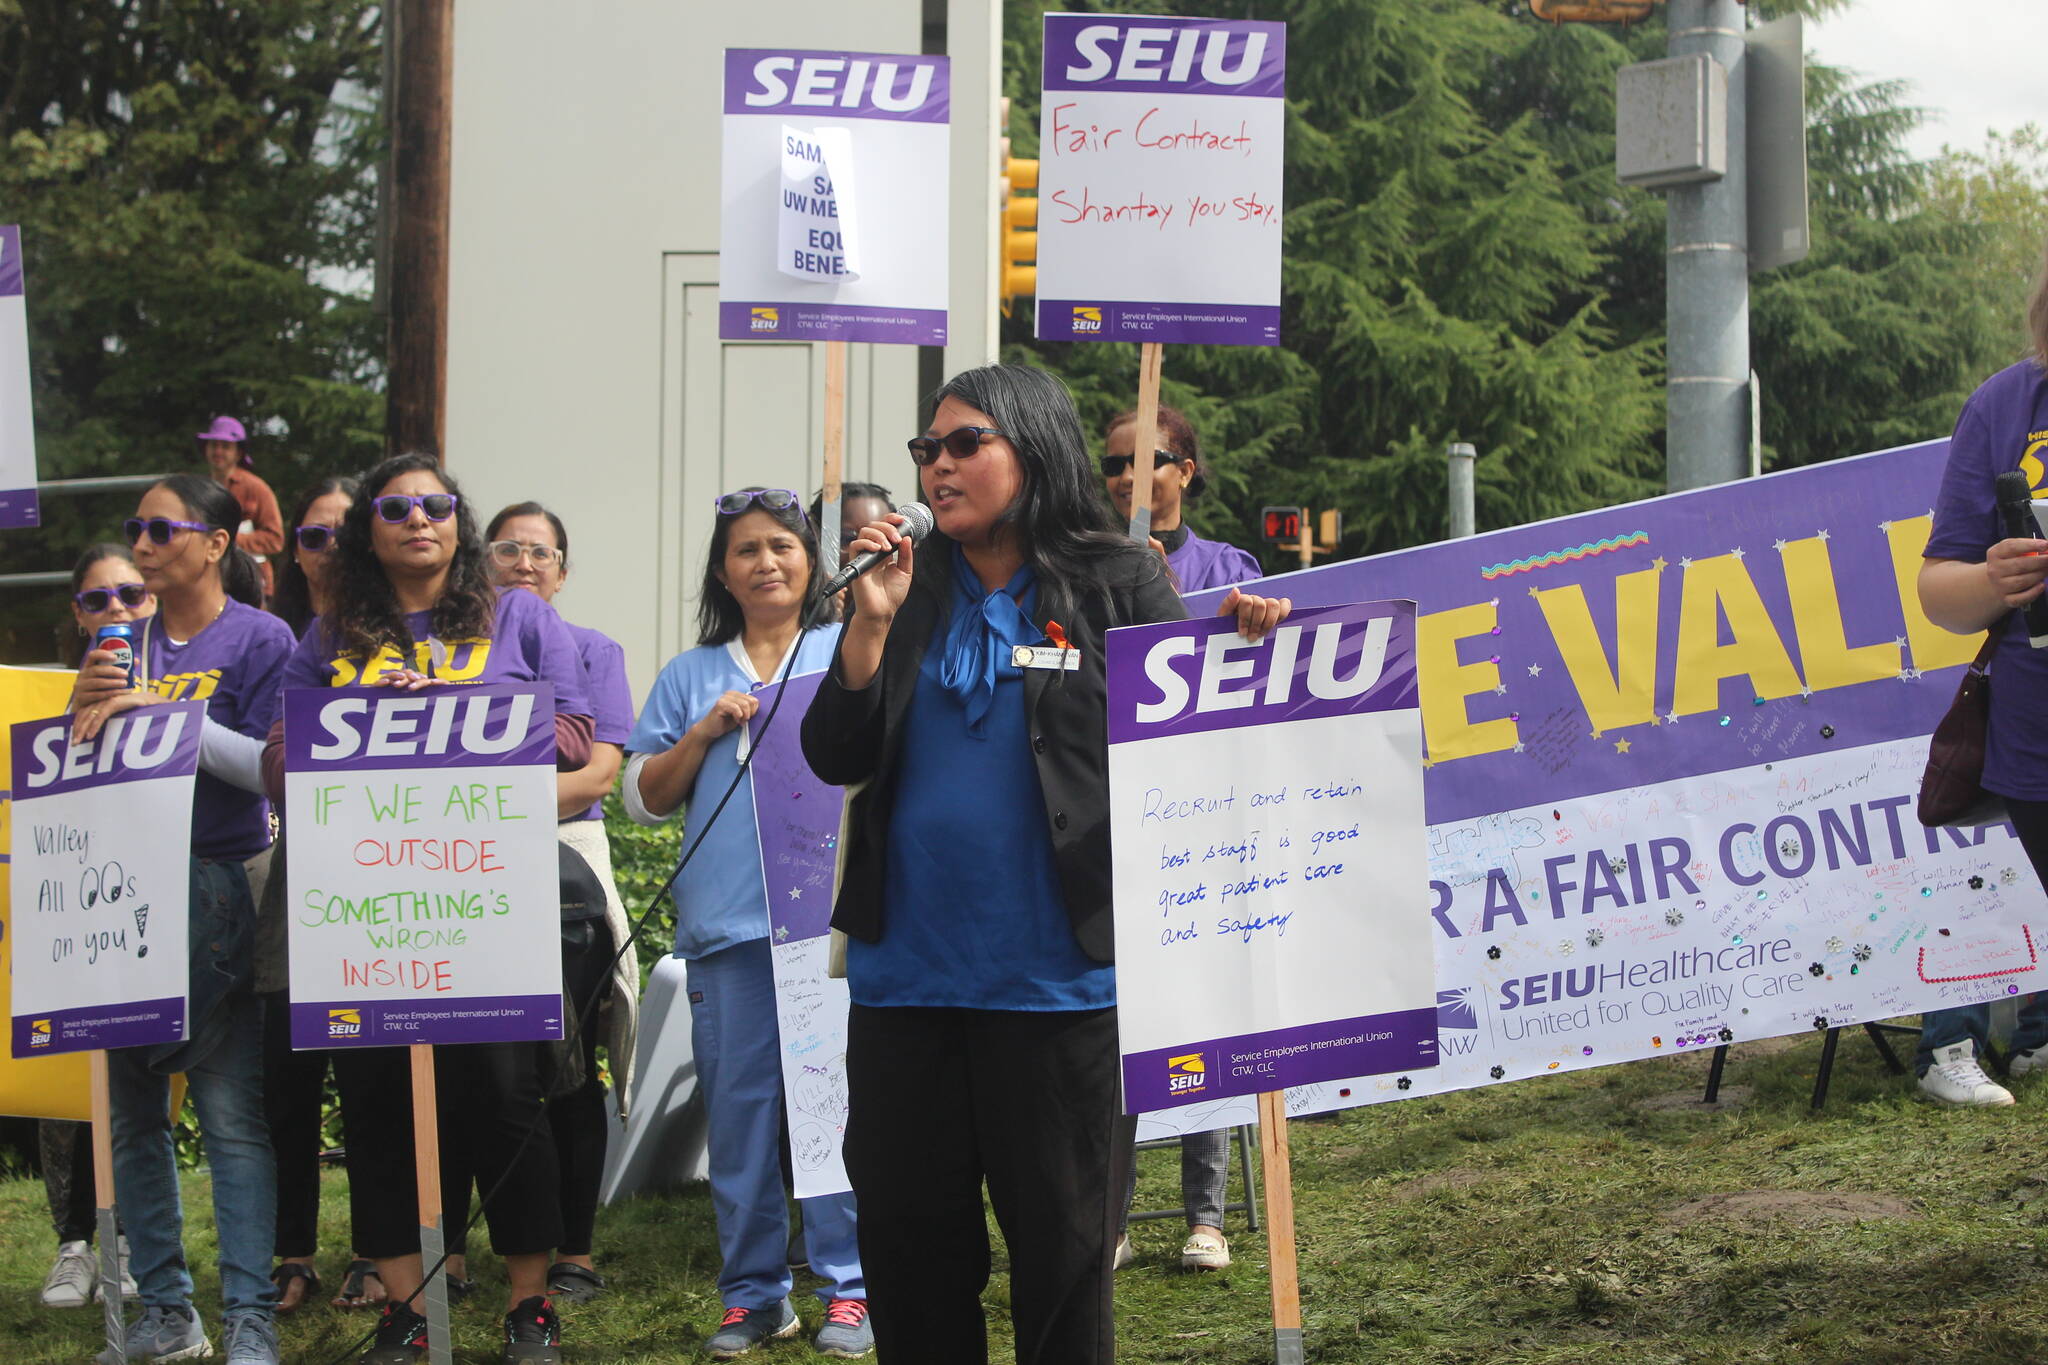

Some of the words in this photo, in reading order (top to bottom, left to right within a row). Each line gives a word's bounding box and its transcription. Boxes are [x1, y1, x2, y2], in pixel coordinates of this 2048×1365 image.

[1066, 25, 1268, 85] SEIU
[745, 56, 934, 112] SEIU
[1054, 103, 1121, 156] Fair
[1136, 108, 1251, 157] Contract,
[786, 135, 826, 165] SAM
[784, 189, 807, 213] UW
[1052, 187, 1173, 230] Shantay
[794, 250, 850, 275] BENE
[751, 320, 778, 330] SEIU
[1072, 321, 1101, 331] SEIU
[1122, 312, 1146, 321] Service
[1147, 313, 1182, 323] Employees
[1184, 314, 1225, 324] International
[1226, 315, 1247, 324] Union
[1140, 322, 1154, 330] CLC
[1136, 616, 1394, 724] SEIU
[311, 694, 538, 760] SEIU
[27, 711, 188, 788] SEIU
[316, 785, 346, 826] IF
[365, 783, 423, 824] WE
[443, 783, 528, 823] ARE
[1250, 786, 1287, 807] and
[1303, 778, 1362, 800] retain
[354, 839, 505, 873] OUTSIDE
[1161, 844, 1191, 870] best
[1202, 830, 1260, 863] staff
[1279, 828, 1290, 848] is
[1311, 823, 1359, 855] good
[39, 879, 64, 912] All
[1159, 882, 1207, 918] great
[1222, 870, 1288, 904] patient
[1304, 863, 1343, 881] care
[1481, 867, 1529, 933] A
[1543, 836, 1701, 919] FAIR
[299, 888, 510, 928] SOMETHING'S
[366, 925, 467, 952] WRONG
[1161, 921, 1198, 946] and
[1217, 911, 1293, 943] safety
[53, 937, 73, 963] on
[343, 958, 452, 992] INSIDE
[383, 1012, 409, 1021] Service
[411, 1011, 451, 1021] Employees
[452, 1008, 499, 1018] International
[500, 1008, 524, 1017] Union
[1502, 1004, 1590, 1041] United
[1599, 999, 1633, 1025] for
[1641, 981, 1734, 1016] Quality
[1742, 973, 1805, 999] Care
[31, 1034, 50, 1045] SEIU
[328, 1024, 361, 1035] SEIU
[404, 1022, 420, 1031] CLC
[1231, 1050, 1262, 1064] Service
[1264, 1044, 1309, 1060] Employees
[1310, 1034, 1364, 1051] International
[1366, 1030, 1393, 1042] Union
[1169, 1073, 1204, 1091] SEIU
[1231, 1063, 1254, 1077] CTW,
[1257, 1062, 1275, 1073] CLC
